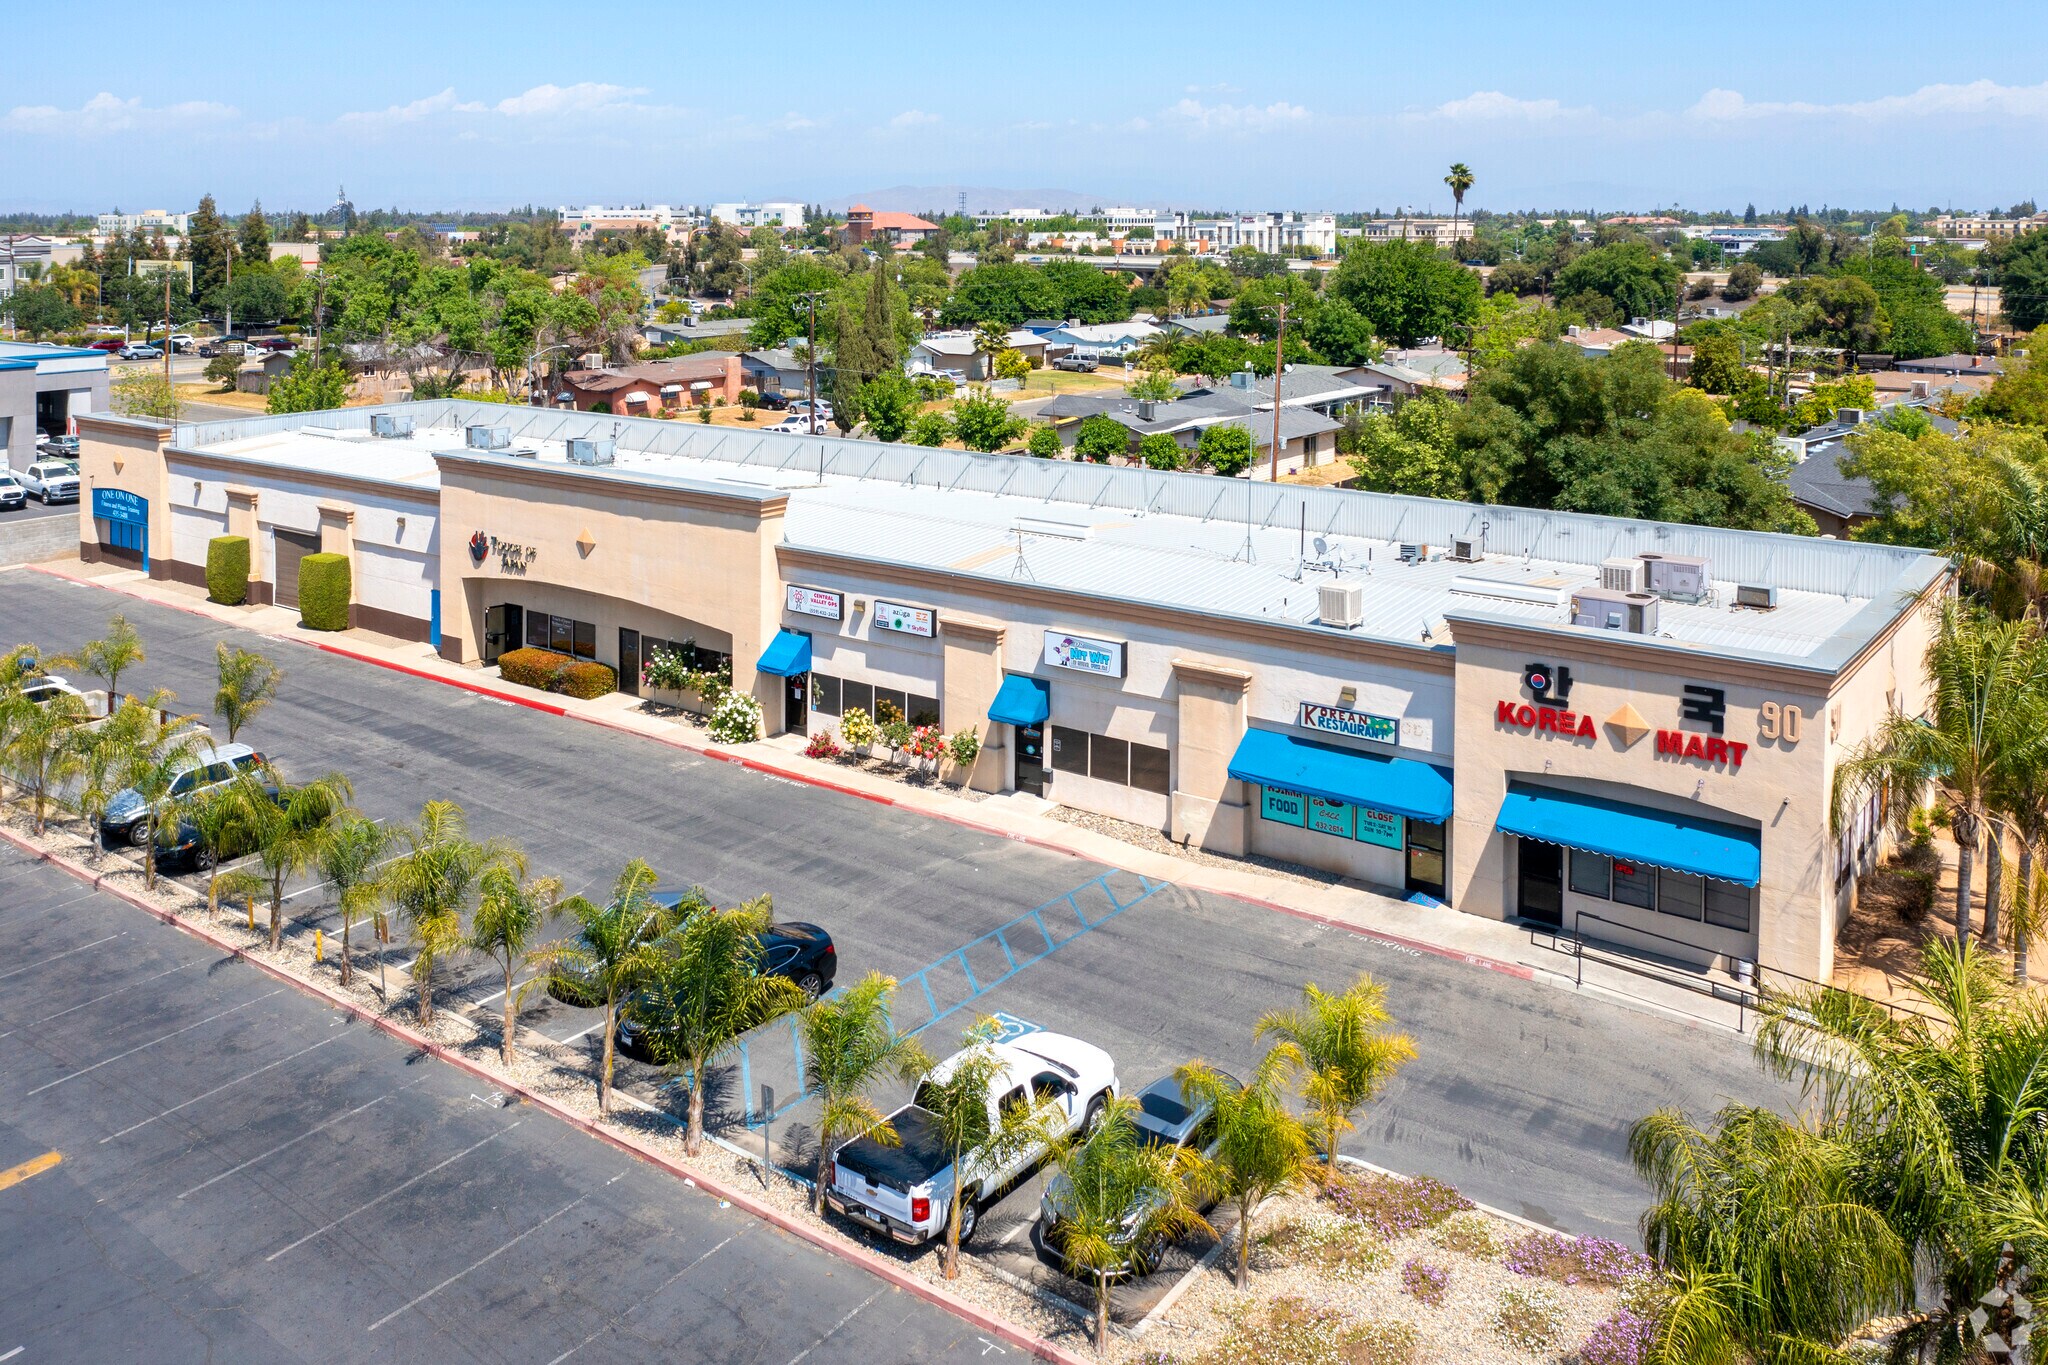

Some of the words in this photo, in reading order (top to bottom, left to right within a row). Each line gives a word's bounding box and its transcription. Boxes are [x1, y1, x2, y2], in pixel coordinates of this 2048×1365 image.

[102, 490, 115, 500] ONE
[115, 490, 125, 500] ON
[125, 493, 138, 506] ONE
[813, 593, 834, 601] CENTRAL
[1070, 648, 1087, 661] NIT
[1089, 651, 1109, 665] WIT
[1304, 705, 1368, 726] KOREAN
[1761, 701, 1802, 743] 90
[1318, 716, 1387, 740] RESTAURANT
[1498, 700, 1596, 739] KOREA
[1657, 729, 1748, 766] MART
[1269, 796, 1298, 815] FOOD
[1367, 810, 1394, 823] CLOSE
[1615, 863, 1634, 875] OPEN
